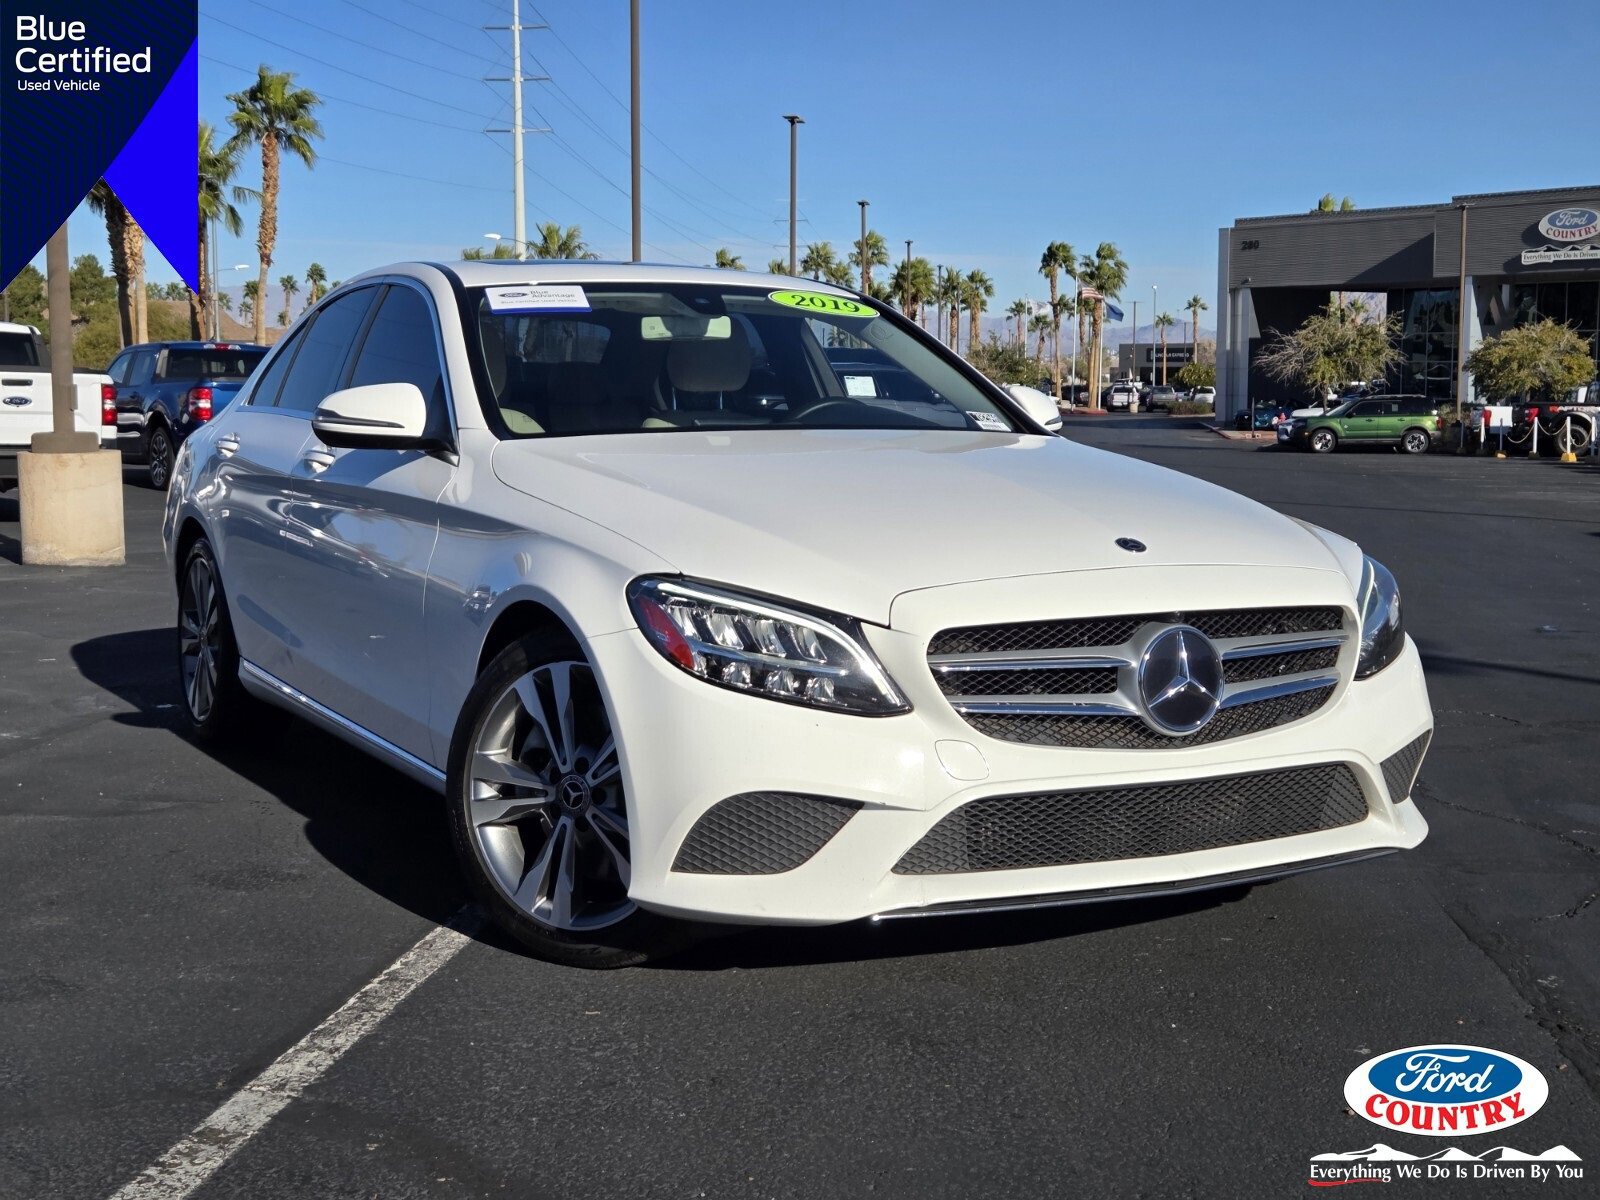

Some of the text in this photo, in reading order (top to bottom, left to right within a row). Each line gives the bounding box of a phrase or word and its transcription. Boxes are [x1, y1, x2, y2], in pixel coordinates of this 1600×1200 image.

[1555, 210, 1589, 226] Ford
[1546, 223, 1599, 239] COUNTRY
[1523, 252, 1552, 261] Everything
[790, 294, 860, 313] 2019
